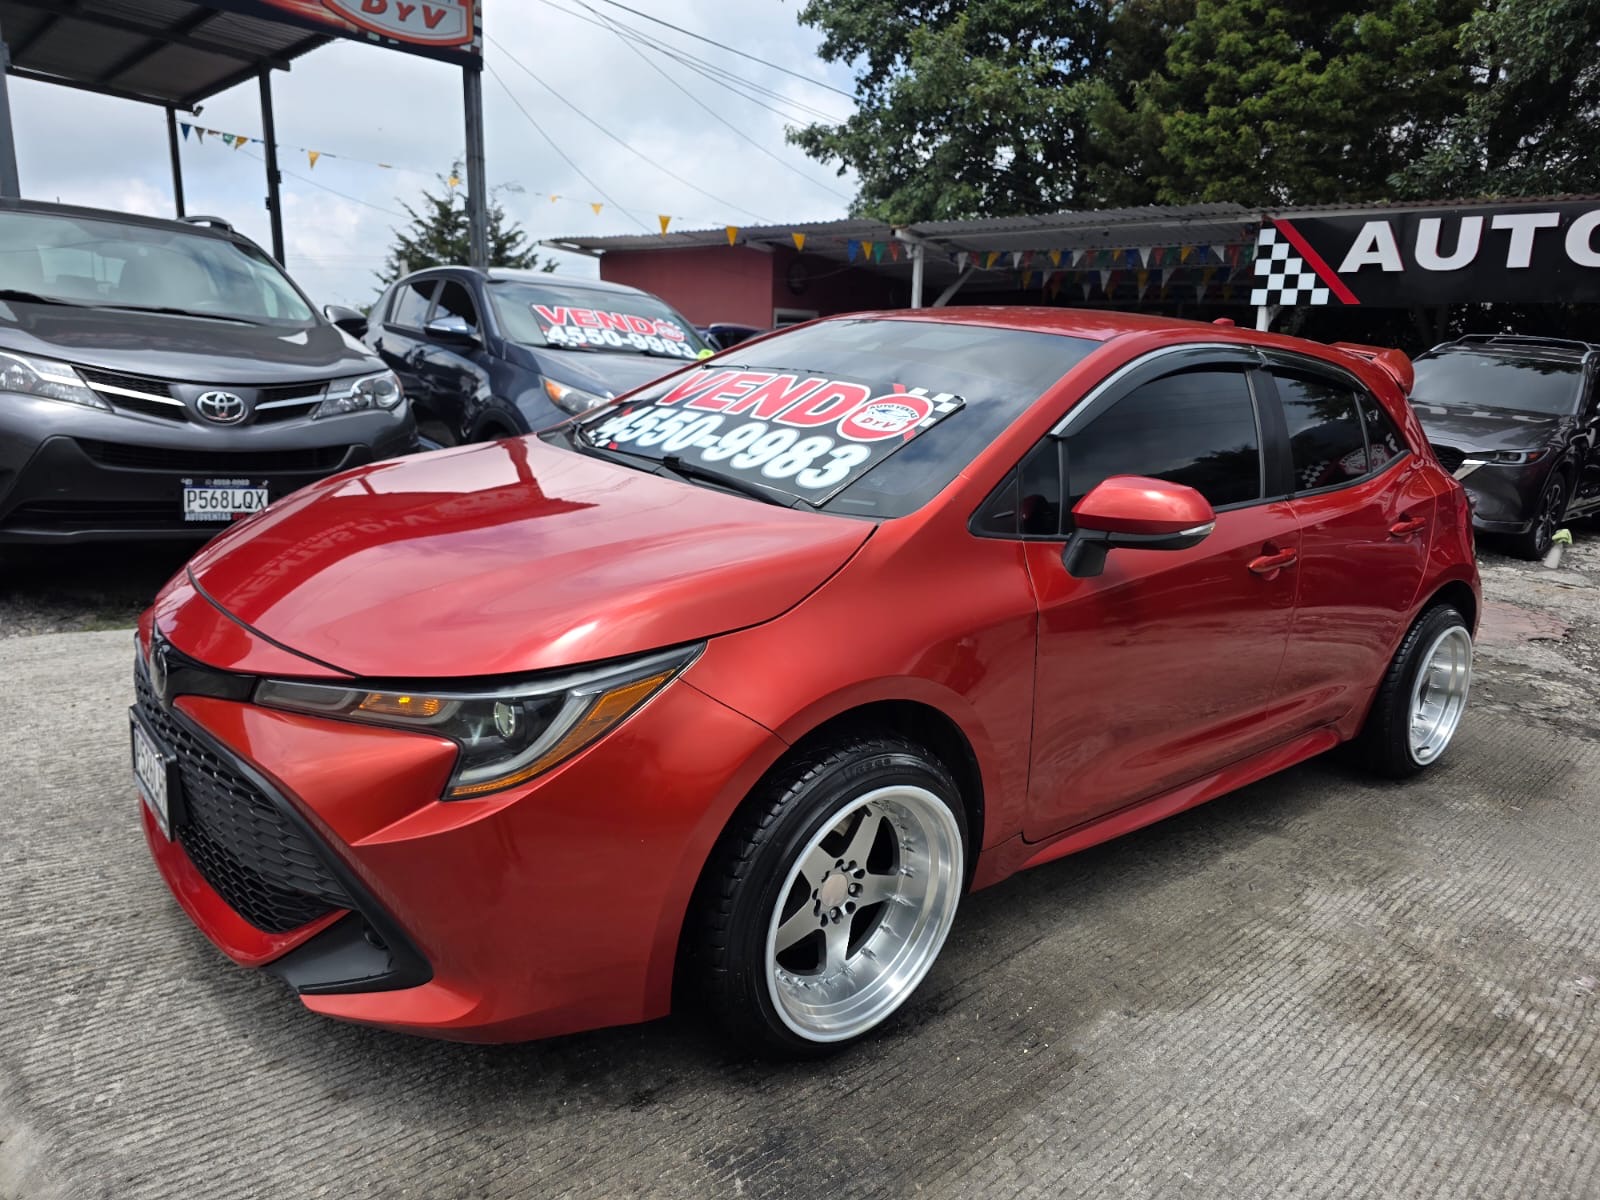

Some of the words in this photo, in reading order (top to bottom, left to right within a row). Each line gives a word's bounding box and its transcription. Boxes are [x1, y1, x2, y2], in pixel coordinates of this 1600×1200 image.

[548, 325, 698, 360] 4550-9983
[596, 406, 872, 488] 4550-9983
[187, 490, 265, 510] P568LQX
